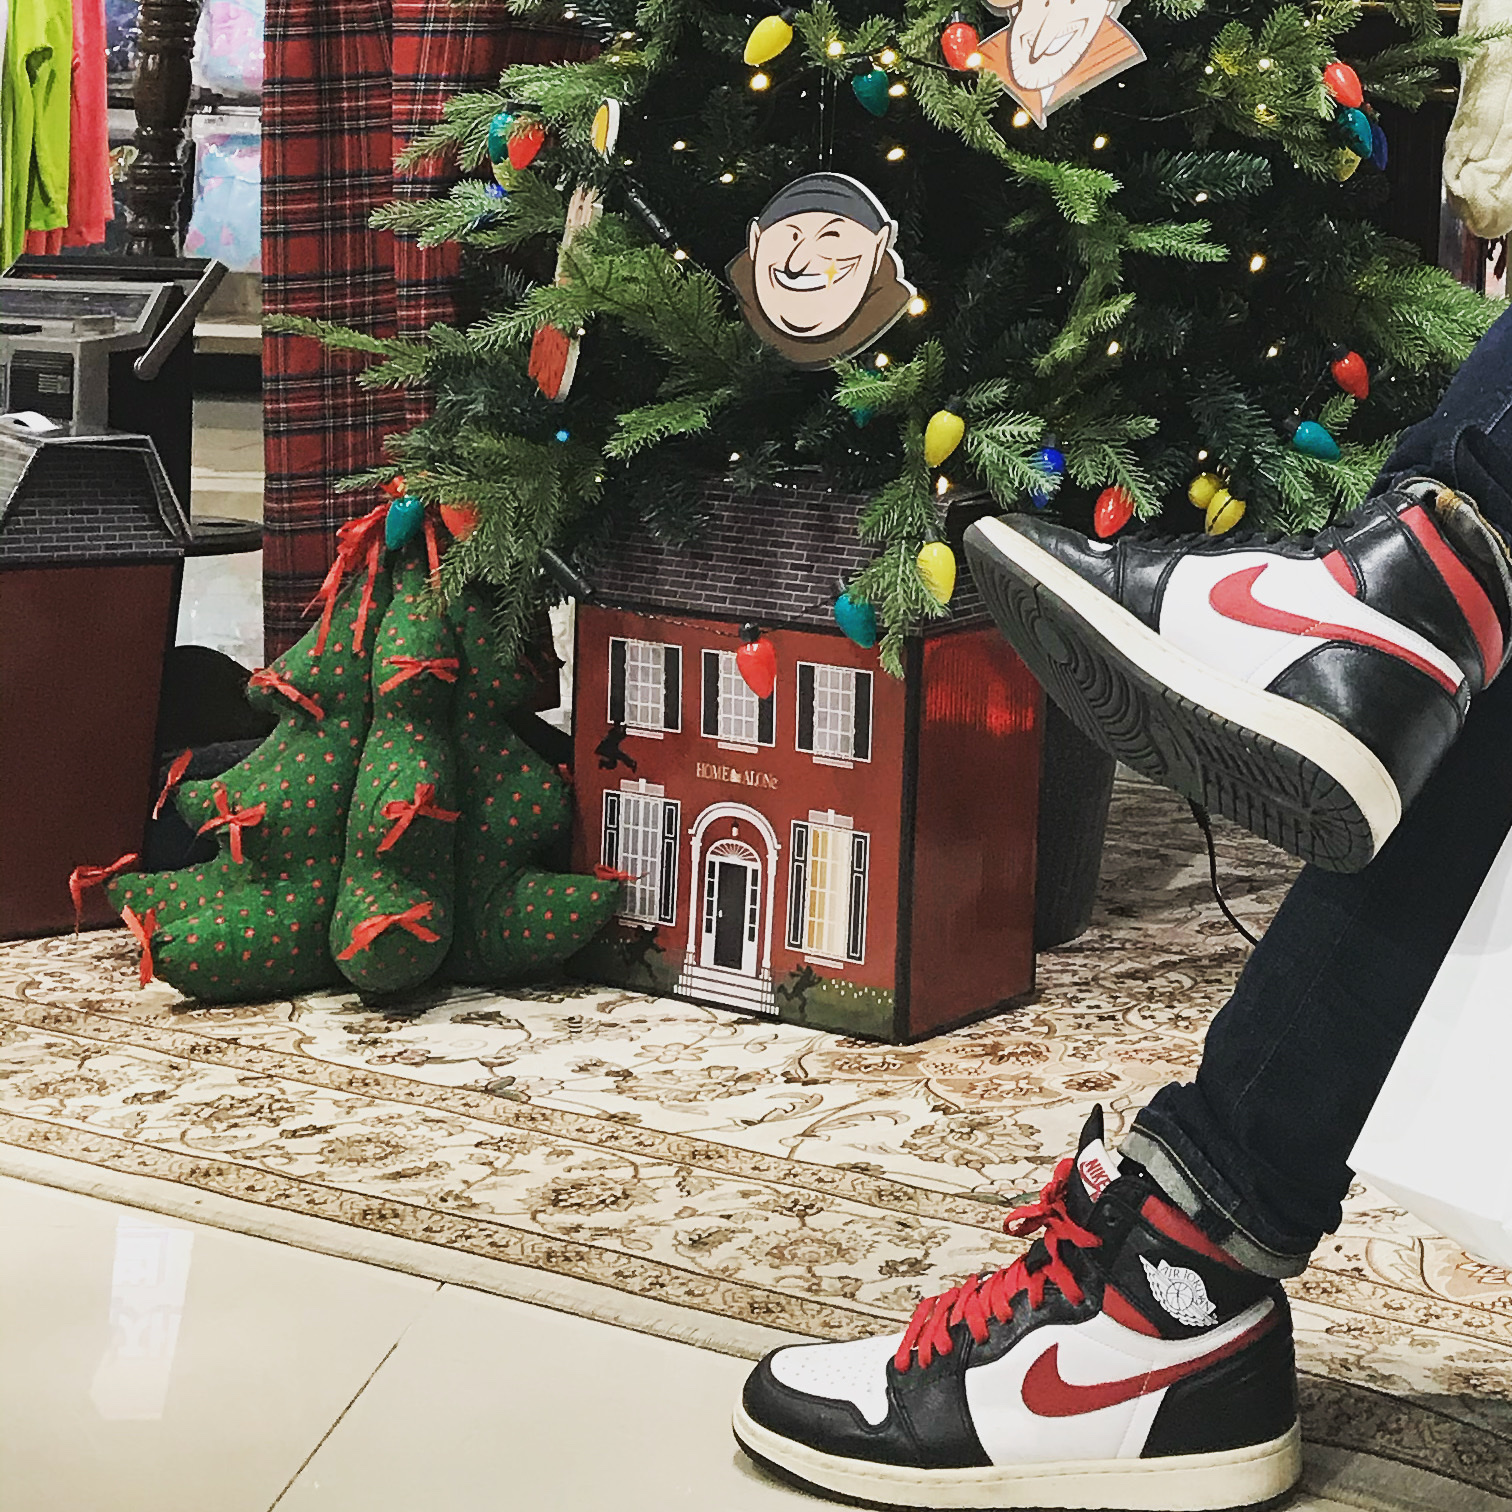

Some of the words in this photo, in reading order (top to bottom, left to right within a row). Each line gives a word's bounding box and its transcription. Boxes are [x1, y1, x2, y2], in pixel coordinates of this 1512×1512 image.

[696, 762, 730, 782] HOME
[1085, 1158, 1111, 1187] NIKE
[1160, 1266, 1180, 1278] AIR
